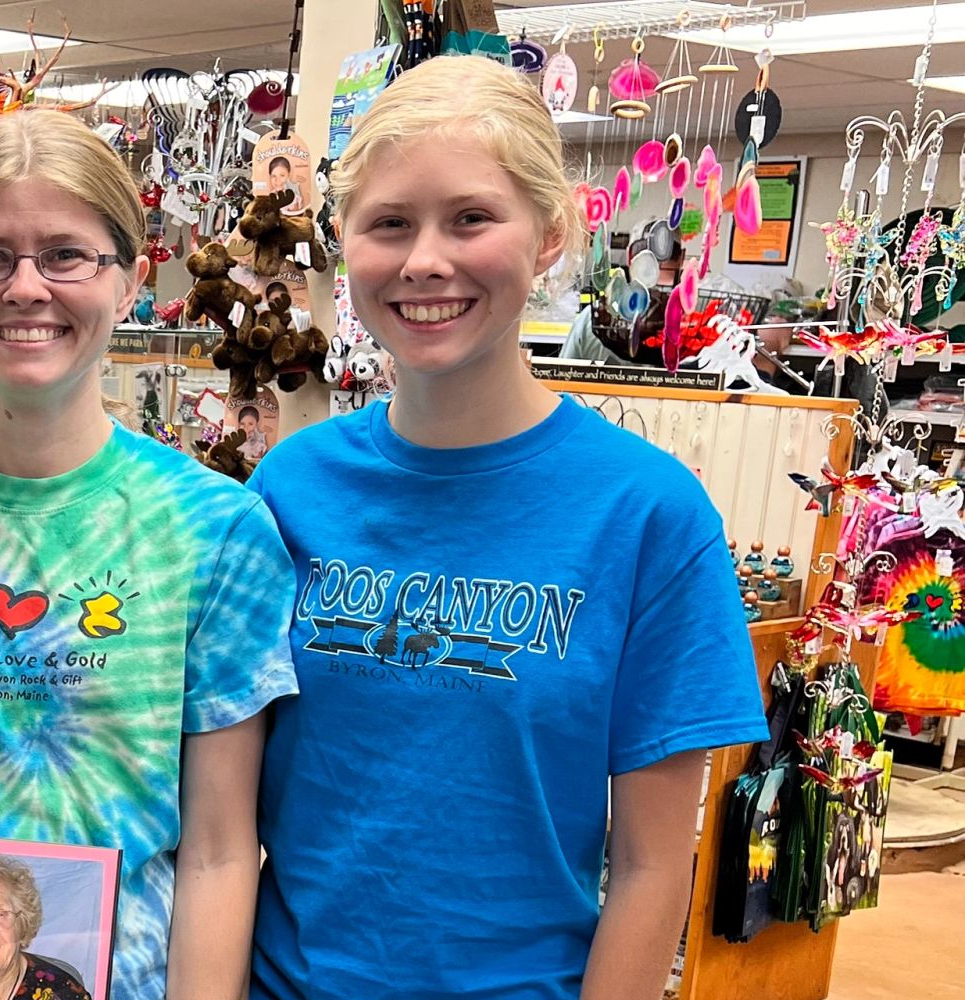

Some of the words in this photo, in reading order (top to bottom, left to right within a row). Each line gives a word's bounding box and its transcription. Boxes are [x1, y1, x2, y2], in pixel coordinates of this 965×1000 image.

[553, 367, 584, 381] Laughter
[585, 369, 599, 379] and
[599, 370, 625, 381] Friends
[626, 374, 638, 382] are
[639, 371, 663, 386] always
[664, 373, 695, 385] welcome
[696, 374, 716, 386] here!
[395, 572, 585, 660] CANYON
[44, 651, 59, 669] &
[66, 651, 107, 669] Gold
[20, 673, 46, 685] Rock
[49, 675, 57, 685] &
[62, 674, 83, 686] Gift
[328, 659, 406, 684] BYRON,
[16, 689, 49, 701] Maine
